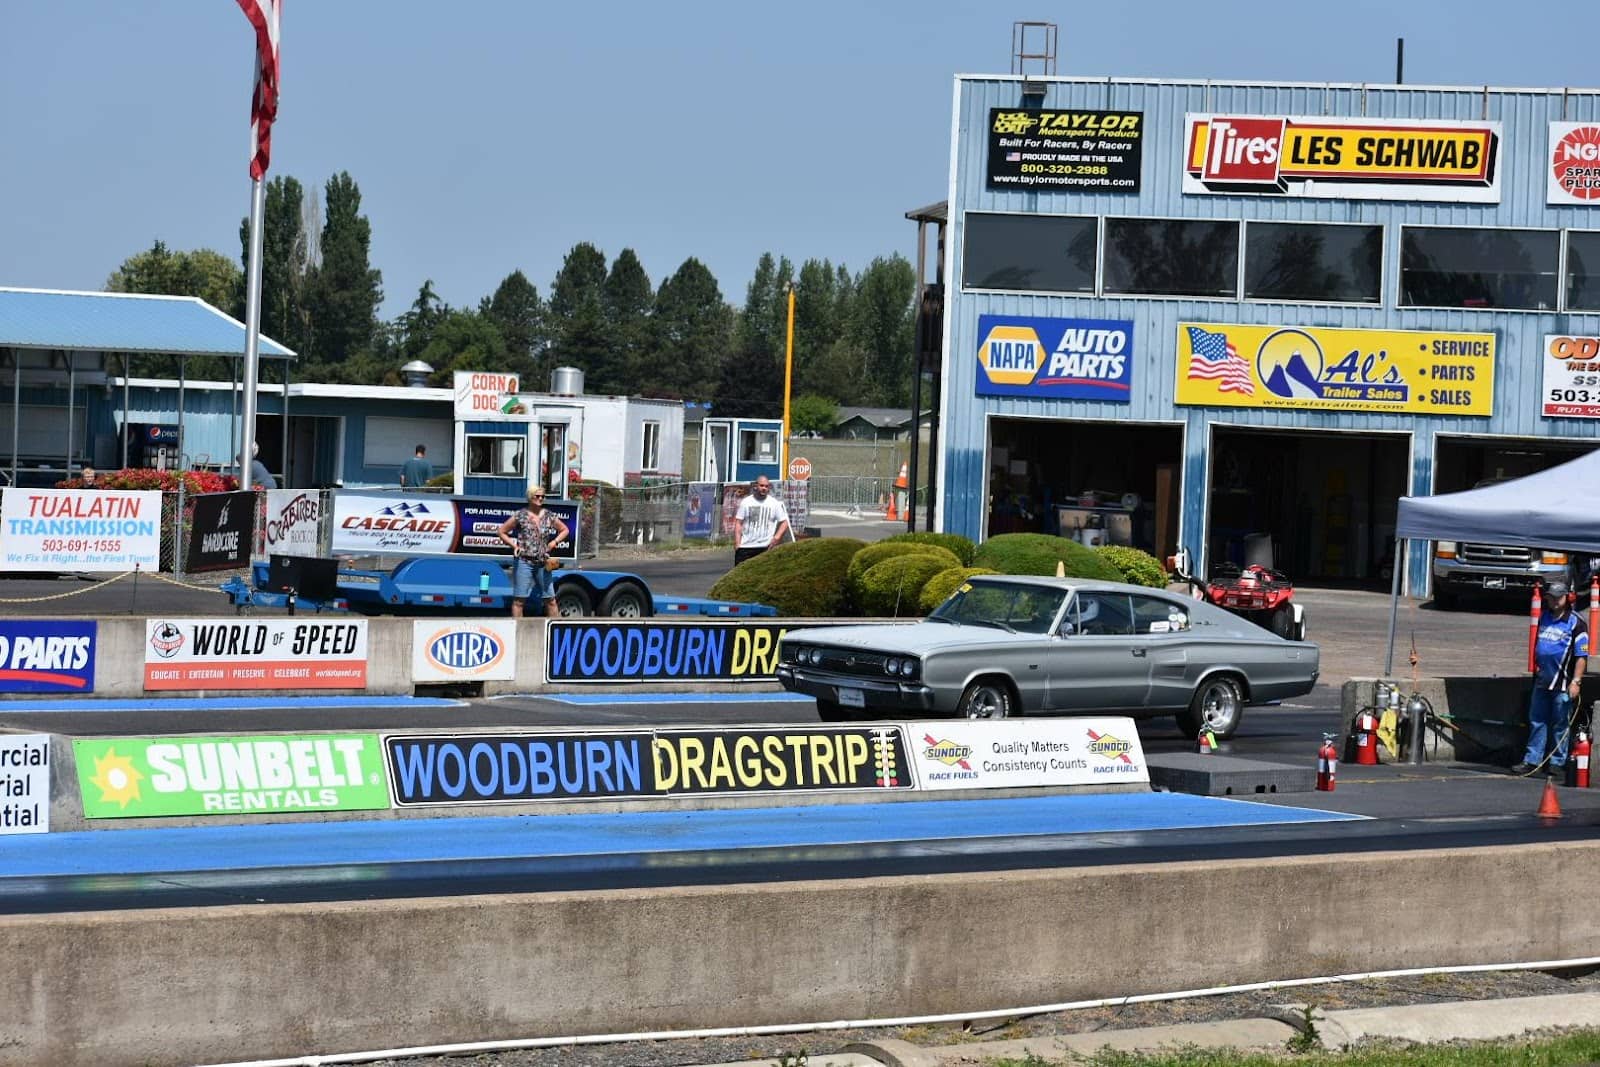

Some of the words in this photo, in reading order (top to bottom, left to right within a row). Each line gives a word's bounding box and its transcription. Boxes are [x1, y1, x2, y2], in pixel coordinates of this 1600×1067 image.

[1039, 113, 1140, 129] TAYLOR
[1038, 128, 1095, 138] Motorsports
[1098, 128, 1139, 138] Products
[999, 138, 1023, 147] Built
[1024, 139, 1041, 148] For
[1043, 139, 1080, 149] Racers,
[1082, 140, 1096, 151] By
[1098, 141, 1132, 150] Racers
[1210, 122, 1280, 175] Tires
[1291, 136, 1343, 166] LES
[1356, 137, 1481, 169] SCHWAB
[1564, 143, 1600, 161] NG
[1058, 154, 1080, 162] MADE
[1107, 155, 1123, 163] USA
[1020, 164, 1108, 175] 800-320-2988
[993, 174, 1135, 187] www.taylormotorsports.com
[1057, 328, 1126, 354] AUTO
[1432, 340, 1489, 357] SERVICE
[1550, 337, 1600, 360] OD
[990, 342, 1034, 369] NAPA
[1048, 353, 1126, 379] PARTS
[1324, 350, 1404, 384] Al's
[1431, 366, 1475, 381] PARTS
[472, 374, 506, 391] CORN
[1322, 386, 1362, 399] Trailer
[1366, 387, 1403, 400] Sales
[1430, 389, 1472, 406] SALES
[472, 394, 498, 411] DOG
[1262, 399, 1405, 410] www.alstrailers.com
[790, 465, 810, 475] STOP
[28, 496, 141, 518] TUALATIN
[8, 519, 154, 536] TRANSMISSION
[267, 493, 318, 545] CRABTREE
[341, 516, 451, 533] CASCADE
[42, 539, 121, 552] 503-691-1555
[202, 531, 239, 553] HARDCORE
[7, 554, 22, 562] We
[24, 554, 40, 562] Fix
[193, 624, 268, 655] WORLD
[273, 632, 285, 646] OF
[292, 624, 358, 655] SPEED
[10, 636, 91, 670] PARTS
[437, 633, 494, 666] NHRA
[553, 628, 725, 676] WOODBURN
[150, 670, 180, 680] EDUCATE
[189, 669, 224, 679] ENTERTAIN
[232, 669, 265, 679] PRESERVE
[274, 668, 310, 678] CELEBRATE
[927, 747, 969, 759] SUNOCO
[992, 742, 1029, 756] Quality
[1031, 741, 1070, 753] Matters
[1091, 742, 1129, 753] SUNOCO
[146, 739, 365, 793] SUNBELT
[394, 740, 642, 798] WOODBURN
[652, 734, 868, 791] DRAGSTRIP
[983, 760, 1047, 773] Consistency
[1050, 758, 1087, 770] Counts
[1094, 765, 1115, 773] RACE
[1116, 765, 1139, 773] FUELS
[929, 771, 952, 781] RACE
[954, 771, 978, 780] FUELS
[203, 789, 339, 811] RENTALS
